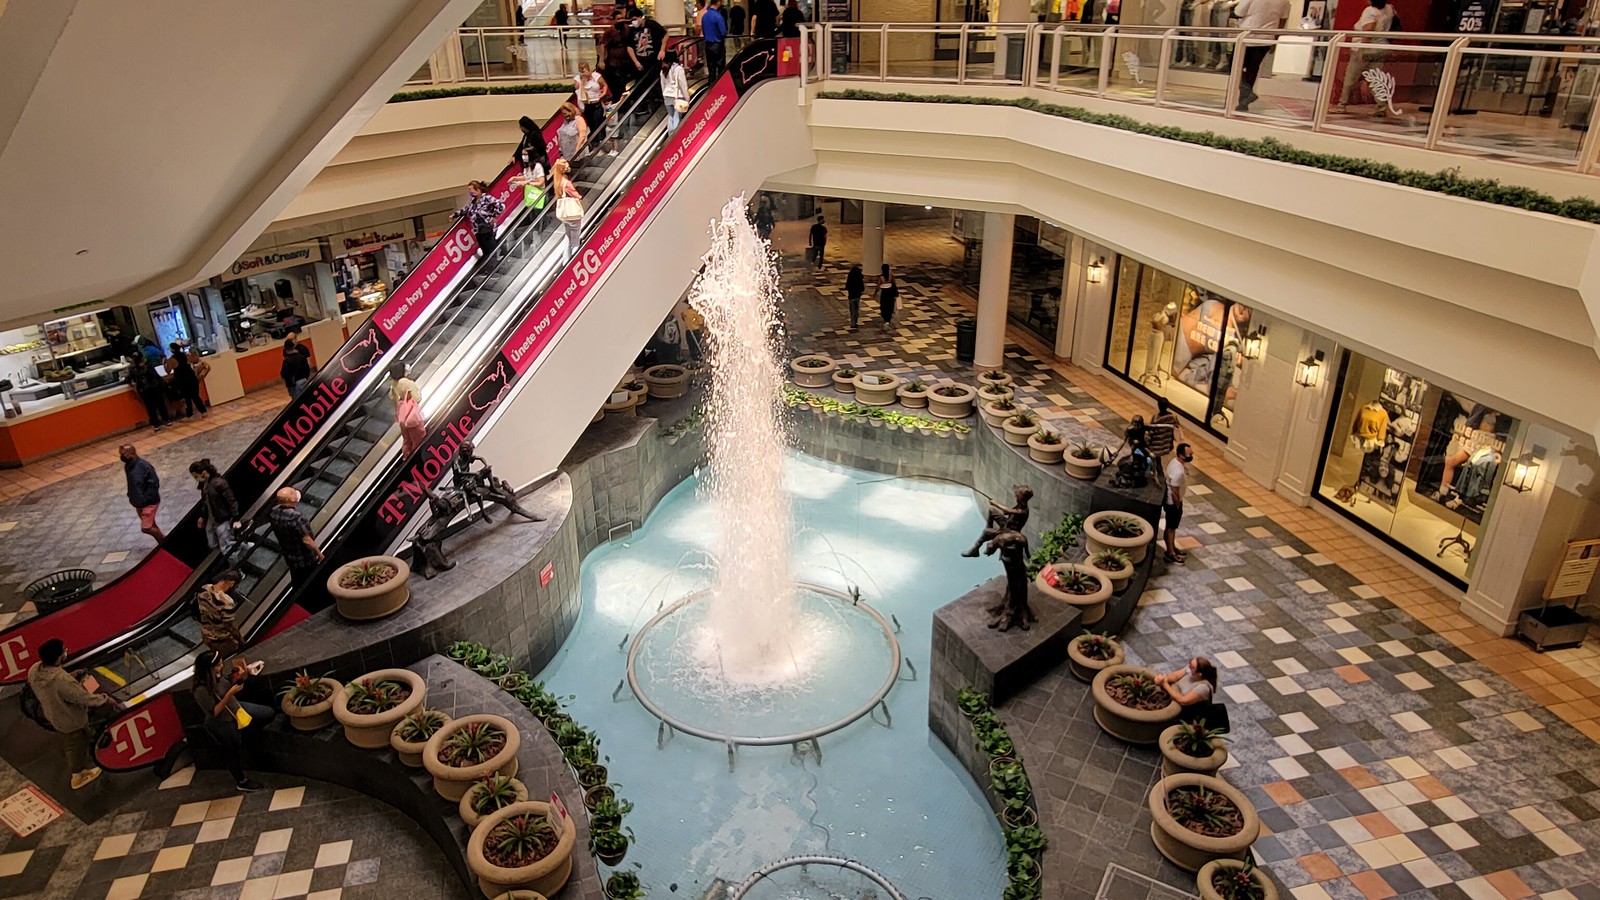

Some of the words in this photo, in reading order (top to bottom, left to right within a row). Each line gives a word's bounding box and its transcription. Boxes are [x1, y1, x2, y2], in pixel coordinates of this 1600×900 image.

[383, 303, 409, 331] Únete
[405, 287, 424, 306] hoy
[421, 281, 429, 290] a
[426, 271, 438, 283] la
[435, 255, 450, 275] red
[444, 228, 475, 264] 5G
[511, 332, 537, 362] Únete
[533, 315, 551, 335] hoy
[549, 307, 557, 317] a
[554, 296, 566, 309] la
[563, 279, 578, 300] red
[572, 248, 602, 287] 5G
[597, 235, 614, 255] más
[612, 206, 637, 239] grande
[635, 196, 646, 209] en
[642, 171, 665, 199] Puerto
[663, 154, 679, 172] Rico
[677, 146, 684, 157] y
[681, 118, 707, 149] Estados
[110, 709, 156, 762] T
